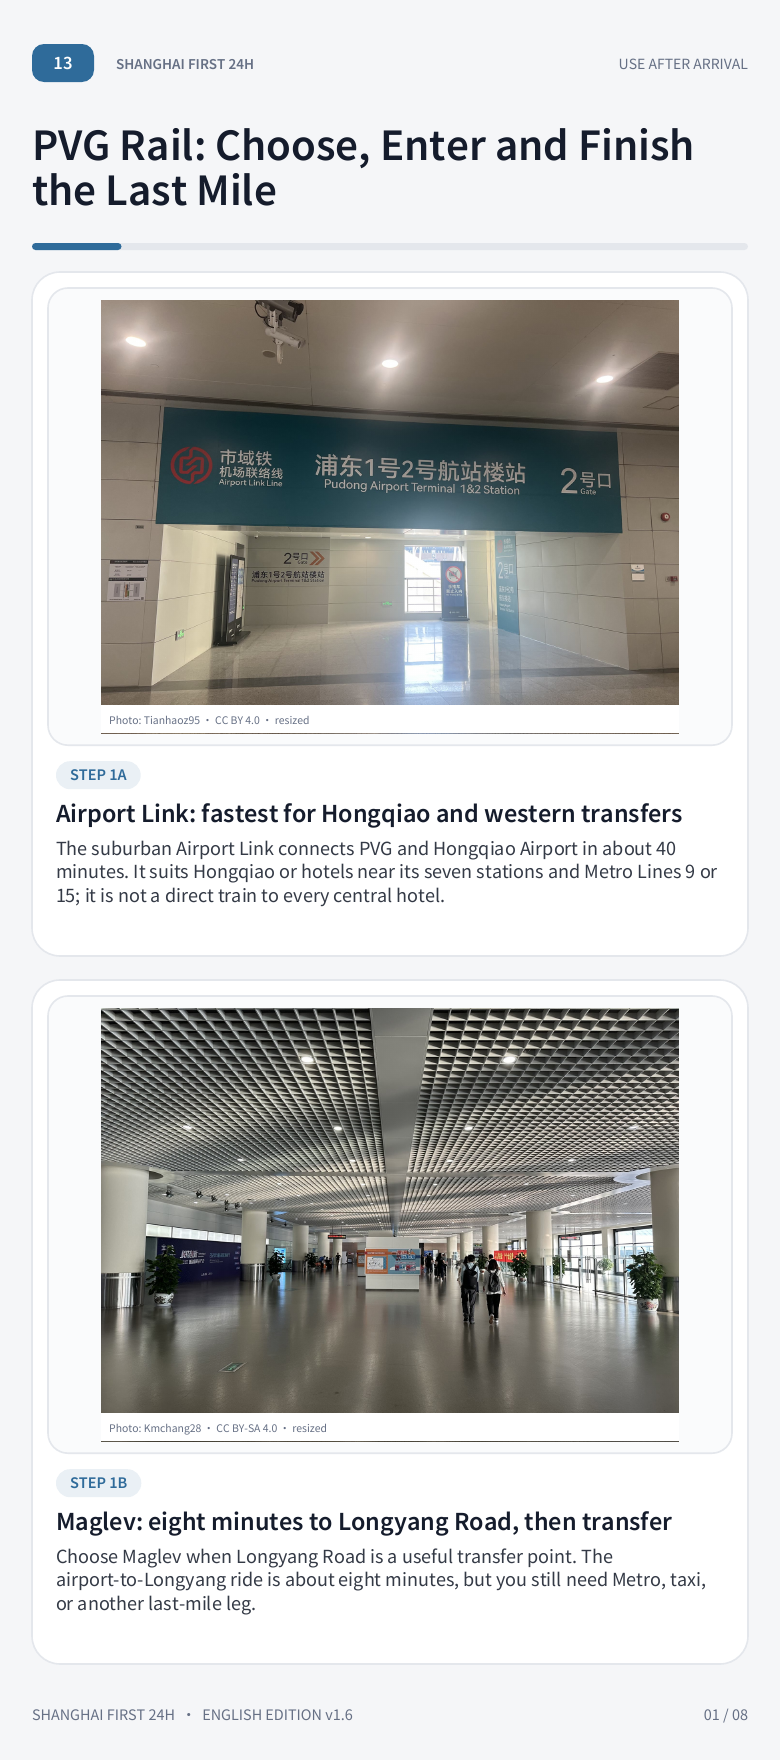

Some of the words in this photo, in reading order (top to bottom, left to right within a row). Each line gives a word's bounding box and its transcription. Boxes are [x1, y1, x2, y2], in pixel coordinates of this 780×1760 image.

[220, 449, 272, 467] 市域铁
[219, 466, 283, 480] 机场联络线
[315, 454, 526, 484] 浦东1号2号航站楼站
[219, 479, 247, 487] Airport
[324, 479, 367, 492] Pudong
[370, 481, 409, 493] Airport
[411, 482, 455, 493] Terminal
[460, 484, 481, 494] 1&2
[483, 485, 520, 495] Station
[561, 467, 611, 494] 2号口
[251, 570, 325, 579] 浦东1号2号航站楼站
